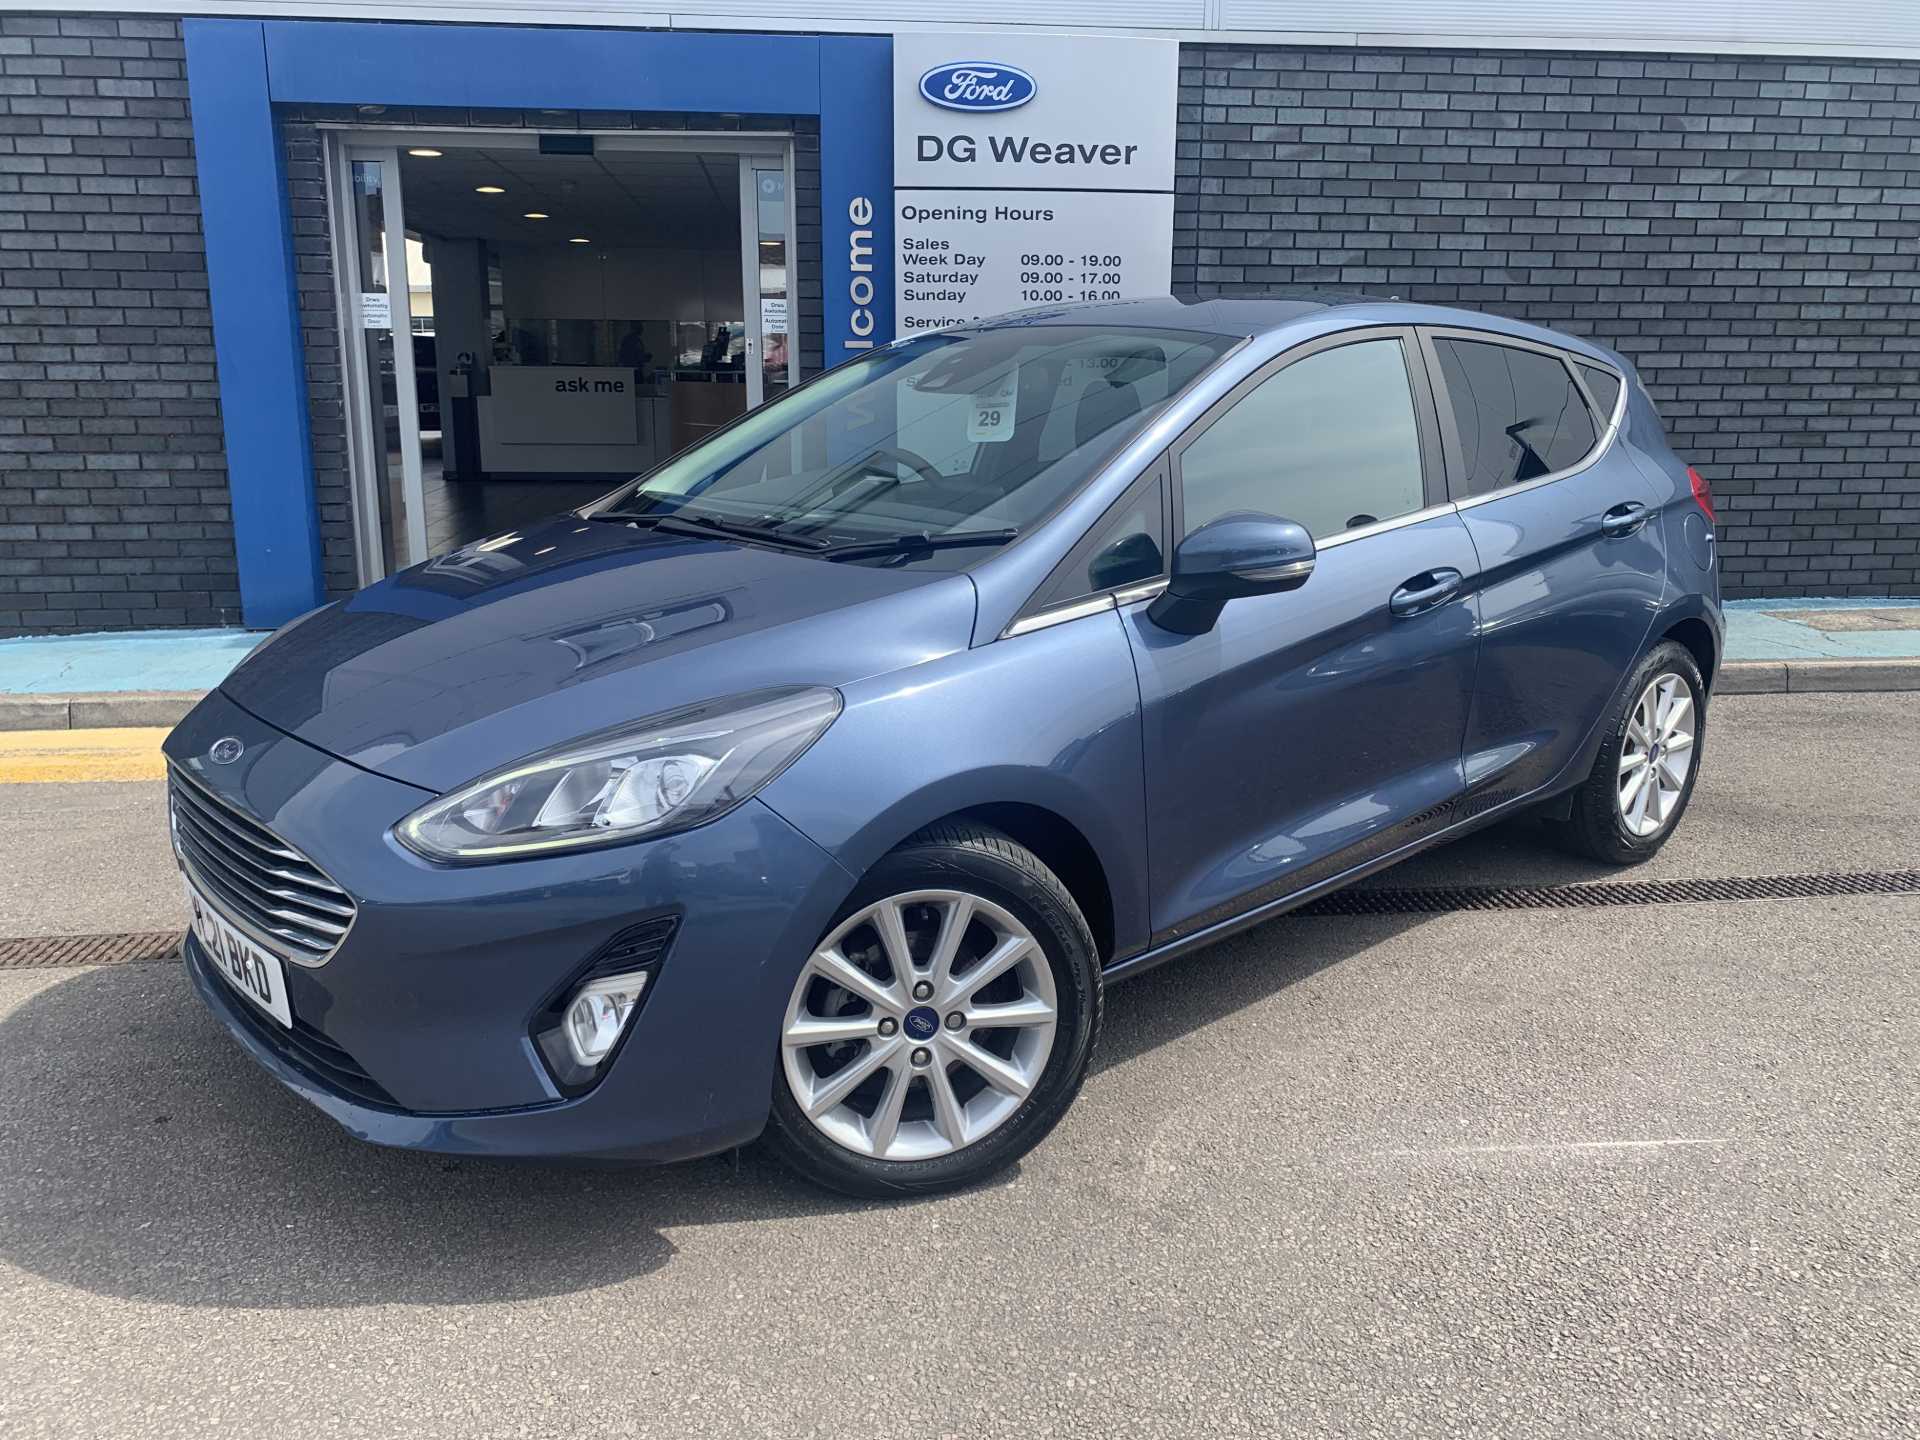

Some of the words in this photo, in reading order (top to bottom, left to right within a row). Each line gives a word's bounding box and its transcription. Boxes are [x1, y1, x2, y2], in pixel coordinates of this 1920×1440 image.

[943, 69, 1015, 102] Ford
[916, 135, 976, 162] DG
[988, 136, 1138, 165] Weaver
[901, 206, 987, 223] Opening
[995, 207, 1054, 221] Hours
[903, 238, 950, 250] Sales
[902, 254, 948, 265] Week
[954, 254, 986, 267] Day
[1020, 254, 1063, 266] 09.00
[1081, 255, 1122, 267] 19.00
[844, 197, 874, 349] lcome
[903, 271, 979, 285] Saturday
[1020, 272, 1063, 284] 09.00
[1080, 273, 1121, 284] 17.00
[903, 289, 967, 303] Sunday
[1021, 290, 1063, 301] 10.00
[1080, 290, 1120, 301] 1600
[555, 377, 590, 393] ask
[594, 380, 625, 393] me
[978, 411, 1001, 427] 29
[224, 928, 272, 1005] BKD
